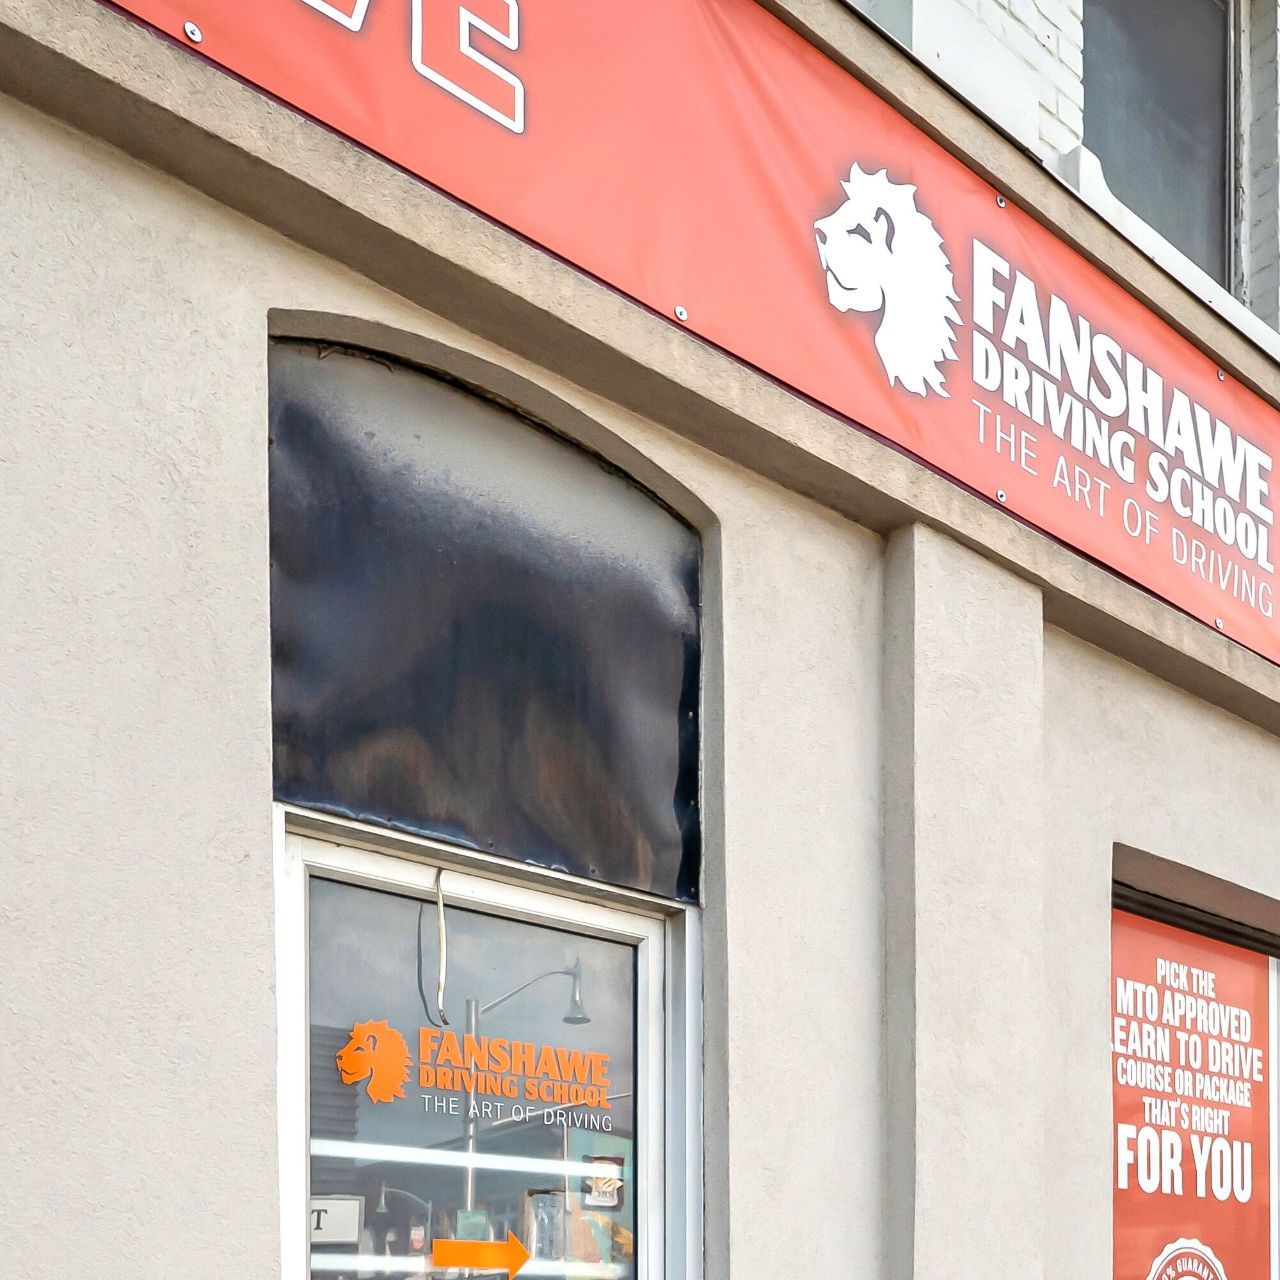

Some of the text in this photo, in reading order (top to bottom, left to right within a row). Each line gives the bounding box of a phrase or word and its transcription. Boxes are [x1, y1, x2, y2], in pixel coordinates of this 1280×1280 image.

[971, 237, 1274, 525] FANSHAWE
[971, 329, 1275, 574] DRIVING SCHOOL
[971, 398, 1274, 619] THE ART OF DRIVING
[1116, 976, 1252, 1043] MTO APPROVED
[1156, 957, 1217, 998] PICK THE
[419, 1027, 612, 1088] FANSHAWE
[1111, 1016, 1264, 1083] EARN TO DRIVE
[419, 1062, 612, 1110] DRIVING SCHOOL
[421, 1094, 612, 1132] THE ART OF DRIVING
[1117, 1056, 1252, 1108] COURSE OR PACKAGE
[1142, 1096, 1231, 1136] THAT'S RIGHT
[1117, 1122, 1253, 1204] FOR YOU
